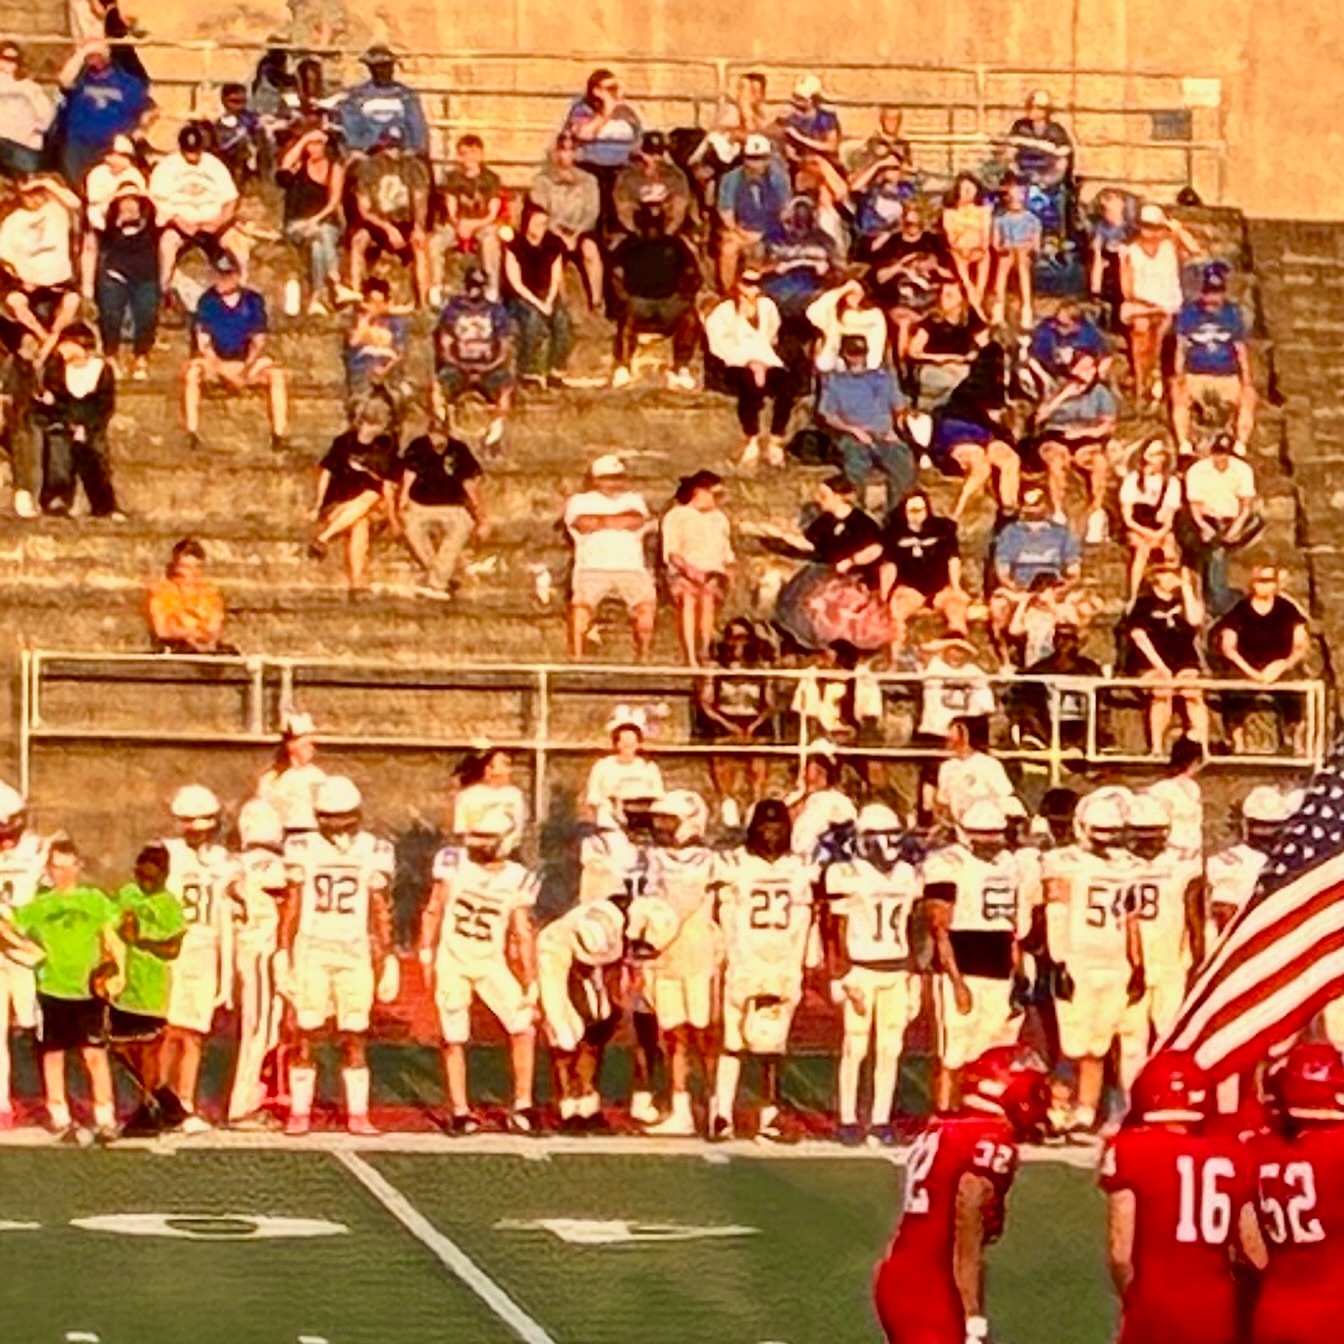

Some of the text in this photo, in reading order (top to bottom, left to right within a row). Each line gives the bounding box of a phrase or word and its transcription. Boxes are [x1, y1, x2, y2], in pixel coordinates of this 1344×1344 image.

[453, 898, 500, 942] 25
[1176, 1154, 1236, 1244] 16
[1258, 1161, 1326, 1244] 52
